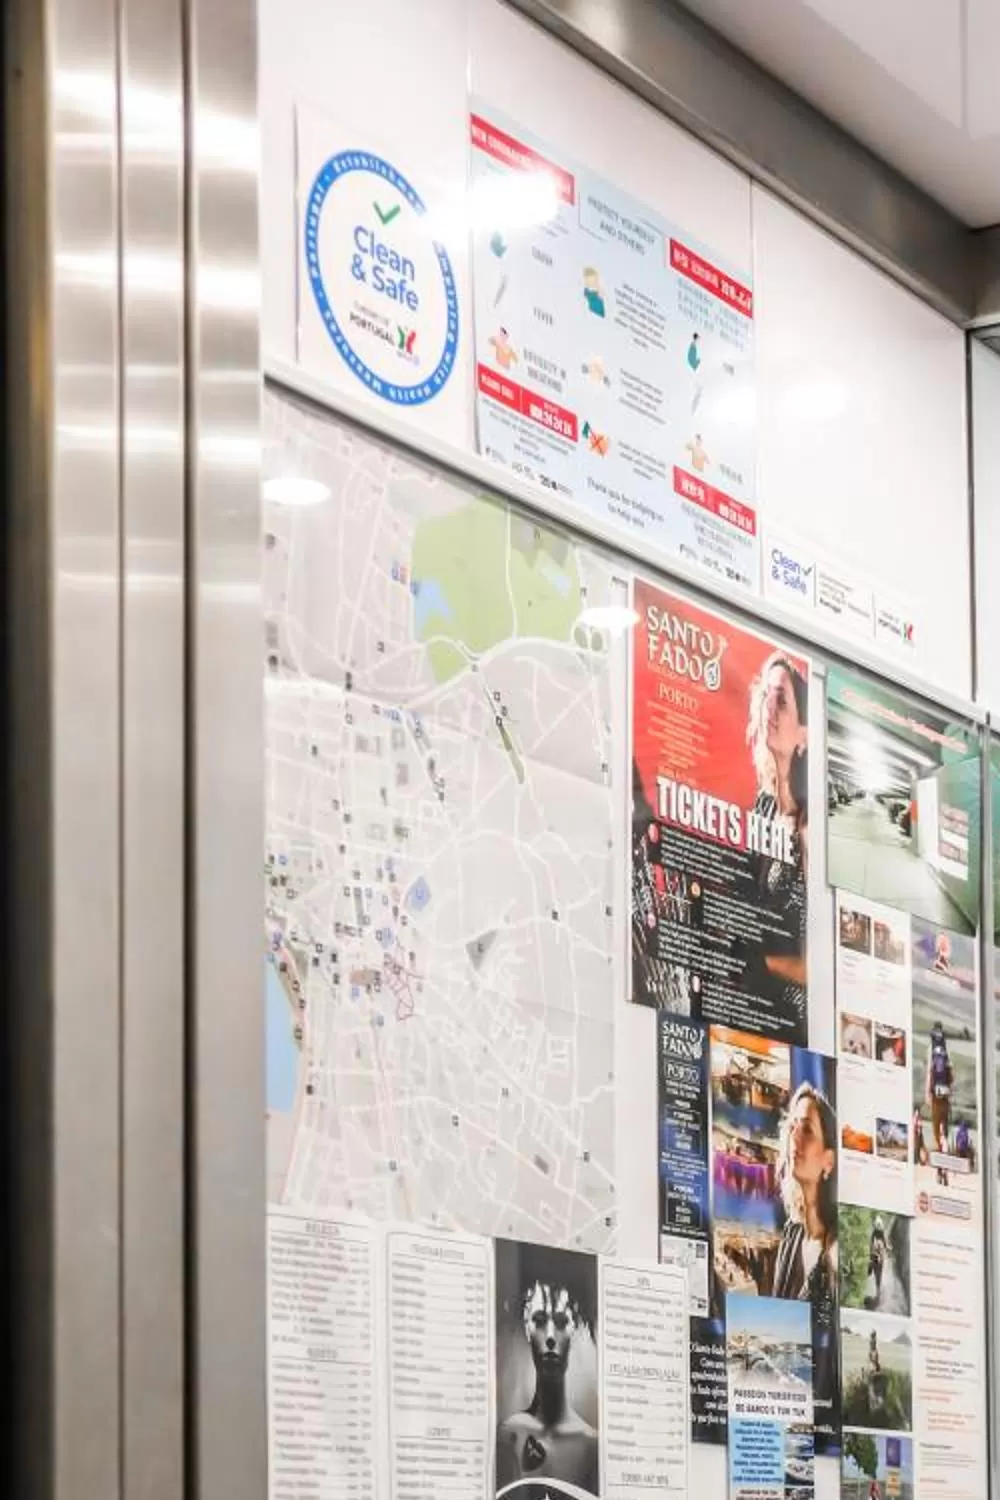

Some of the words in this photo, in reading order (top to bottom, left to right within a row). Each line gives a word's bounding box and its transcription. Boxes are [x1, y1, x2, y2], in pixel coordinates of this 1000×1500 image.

[353, 225, 416, 282] Clean
[350, 253, 367, 284] &
[372, 264, 420, 312] Safe
[771, 548, 801, 575] Clean
[646, 604, 714, 658] SANTO
[647, 632, 703, 681] FADO
[656, 775, 742, 845] TICKETS
[745, 810, 796, 866] HERE
[662, 1020, 699, 1042] SANTO
